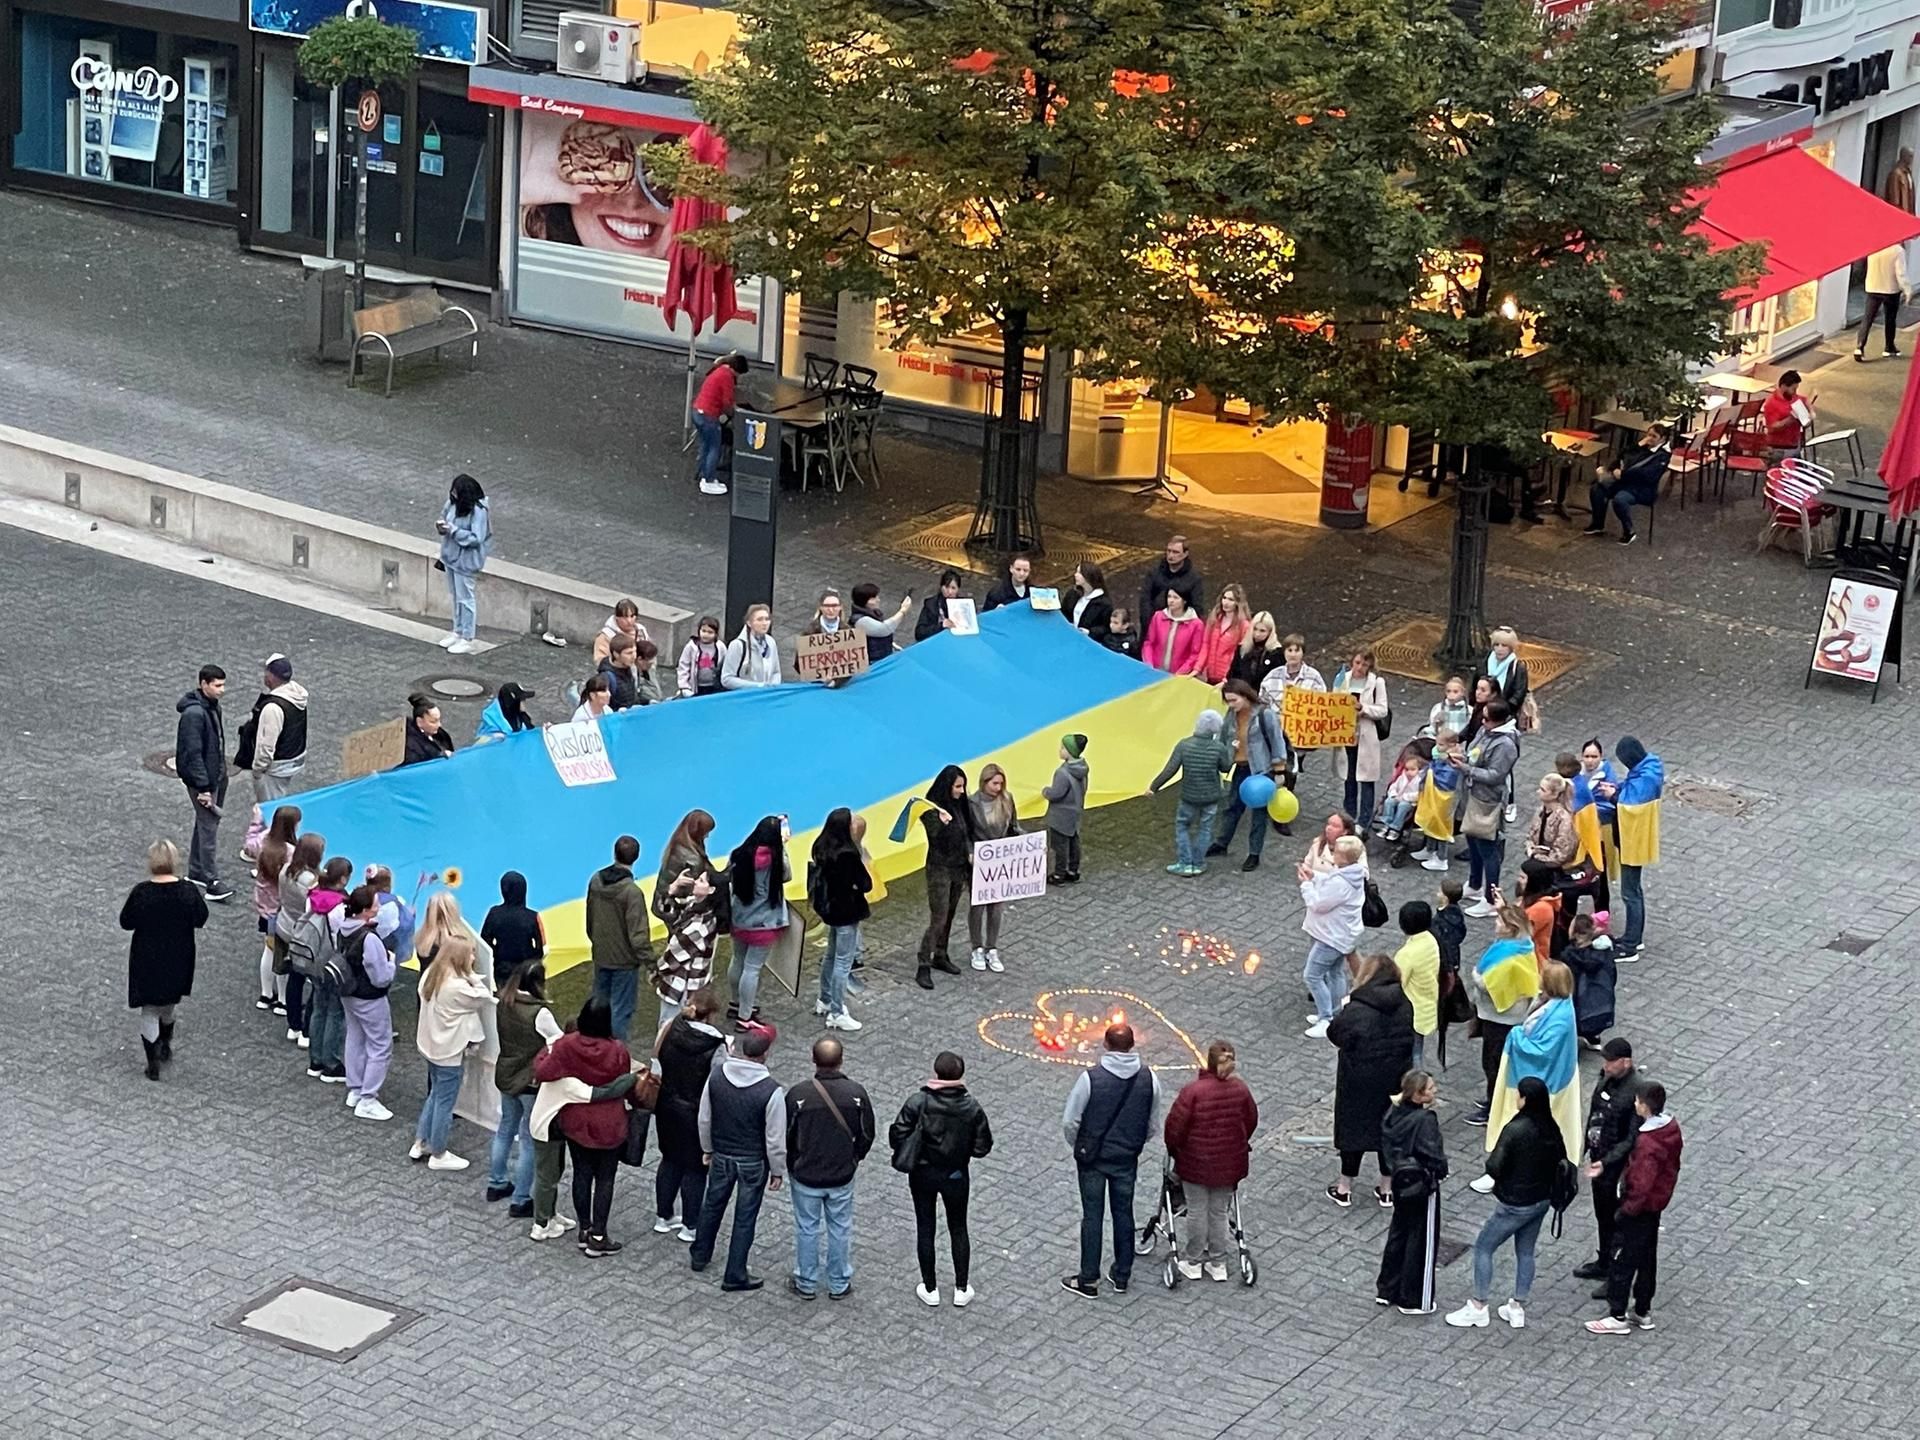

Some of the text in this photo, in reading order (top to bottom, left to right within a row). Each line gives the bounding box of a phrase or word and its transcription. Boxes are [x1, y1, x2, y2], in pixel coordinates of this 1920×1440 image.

[809, 630, 856, 647] RUSSIA
[800, 646, 866, 670] TERRORIST
[816, 661, 860, 679] STATE!
[978, 842, 1024, 861] GEBEN
[977, 888, 998, 902] DER
